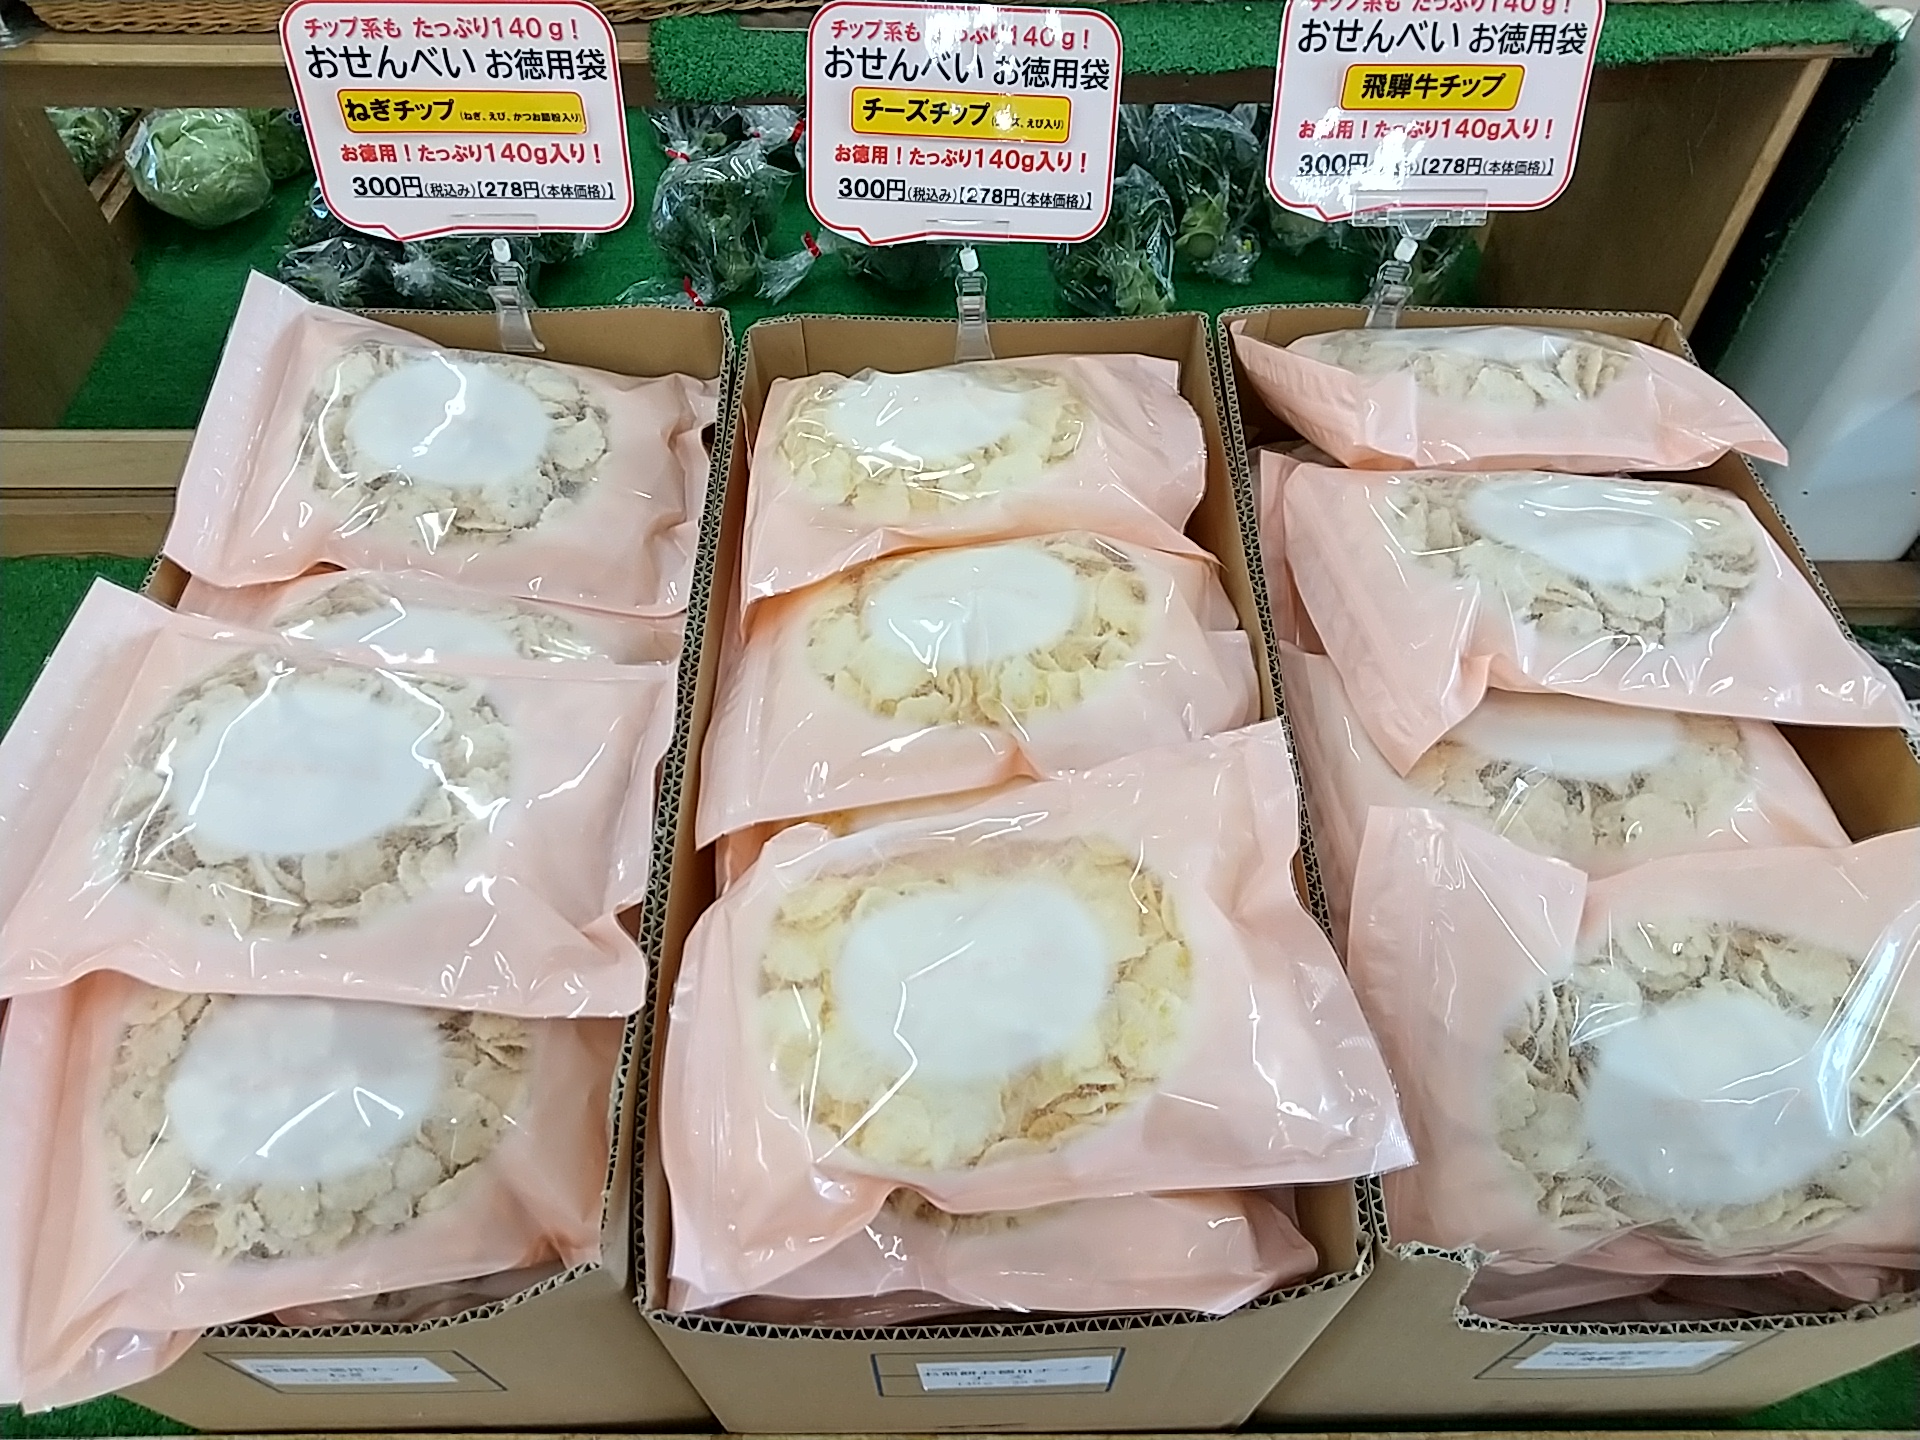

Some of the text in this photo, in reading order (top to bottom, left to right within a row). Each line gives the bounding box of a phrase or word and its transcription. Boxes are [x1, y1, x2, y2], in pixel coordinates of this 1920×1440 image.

[304, 17, 401, 39] チップ系も
[831, 19, 921, 42] チップ系も
[1298, 18, 1588, 56] おせんべい お徳用袋
[305, 44, 607, 81] おせんべい お徳用袋
[824, 45, 1110, 91] おせんべい お徳用袋
[1361, 72, 1506, 99] 飛騨牛チップ
[345, 98, 454, 122] ねぎチップ
[862, 98, 990, 127] チーズチップ
[1299, 118, 1553, 141] お用！たぷり140g入り！
